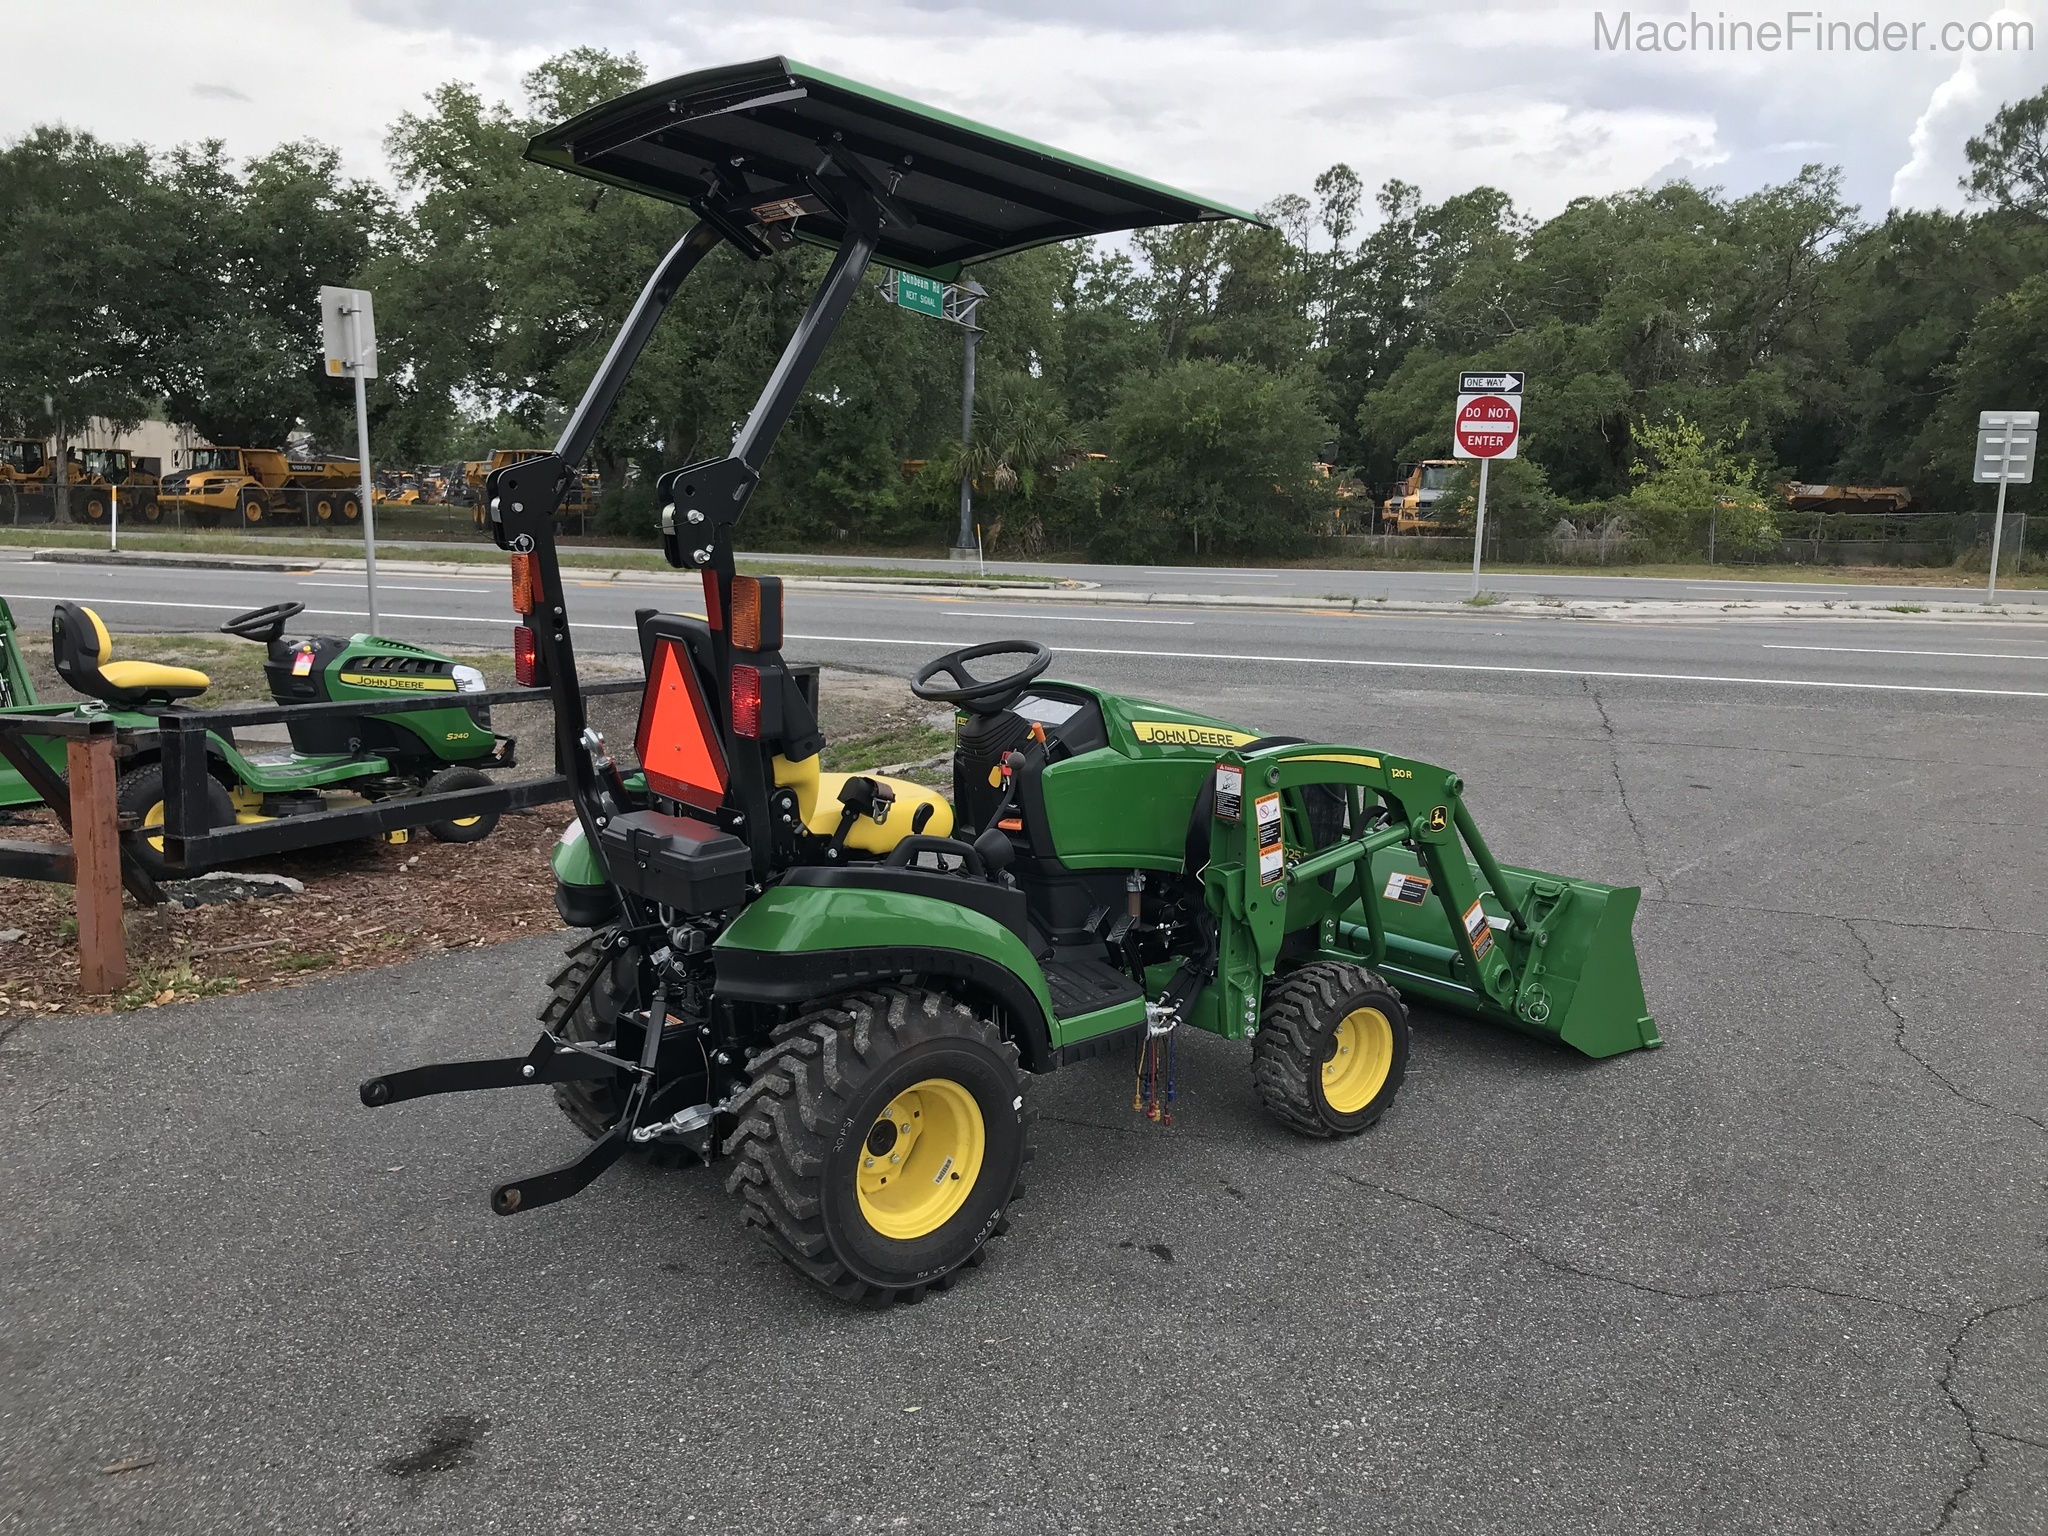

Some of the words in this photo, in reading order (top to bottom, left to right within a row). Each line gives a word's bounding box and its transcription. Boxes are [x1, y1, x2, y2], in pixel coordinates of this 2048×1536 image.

[902, 271, 929, 290] Sunbeam
[932, 281, 940, 294] Rd
[1466, 378, 1484, 387] ONE
[1486, 378, 1505, 387] WAY
[1465, 407, 1481, 418] DO
[1487, 407, 1511, 418] NOT
[1467, 435, 1504, 446] ENTER
[356, 676, 388, 687] JOHN
[389, 678, 425, 689] DEERE
[446, 732, 470, 741] S240
[1146, 727, 1186, 742] JOHN
[1188, 729, 1235, 746] DEERE
